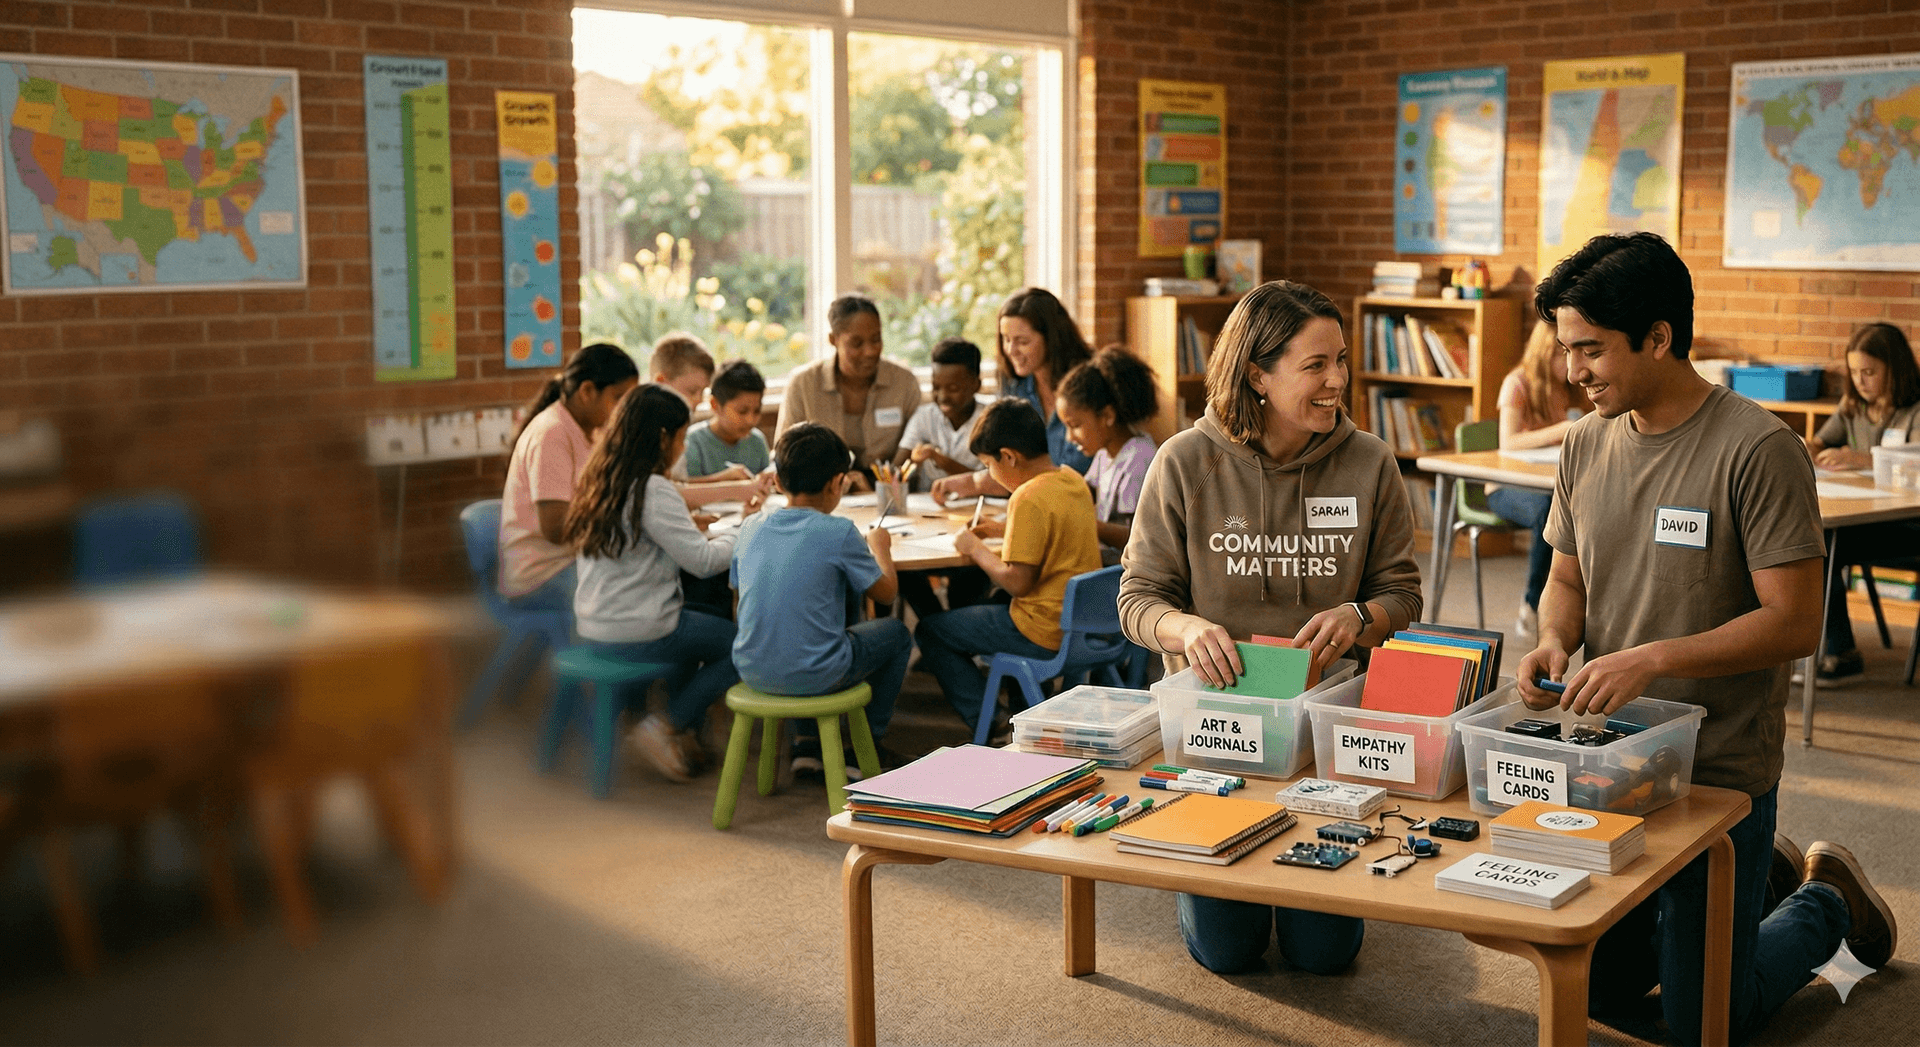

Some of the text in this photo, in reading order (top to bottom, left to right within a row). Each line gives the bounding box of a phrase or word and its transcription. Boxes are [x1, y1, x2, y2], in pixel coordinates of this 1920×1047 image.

[1311, 505, 1349, 517] SARAH
[1661, 518, 1698, 533] DAVID
[1208, 532, 1354, 554] COMMUNITY
[1226, 555, 1338, 577] MATTERS
[1200, 718, 1242, 734] ART &
[1187, 734, 1257, 754] JOURNALS
[1341, 734, 1406, 755] EMPATHY
[1358, 755, 1390, 772] KITS
[1496, 760, 1555, 784] FEELING
[1503, 781, 1550, 802] CARDS
[1474, 870, 1541, 888] CARDS
[1478, 860, 1559, 881] FEELING
